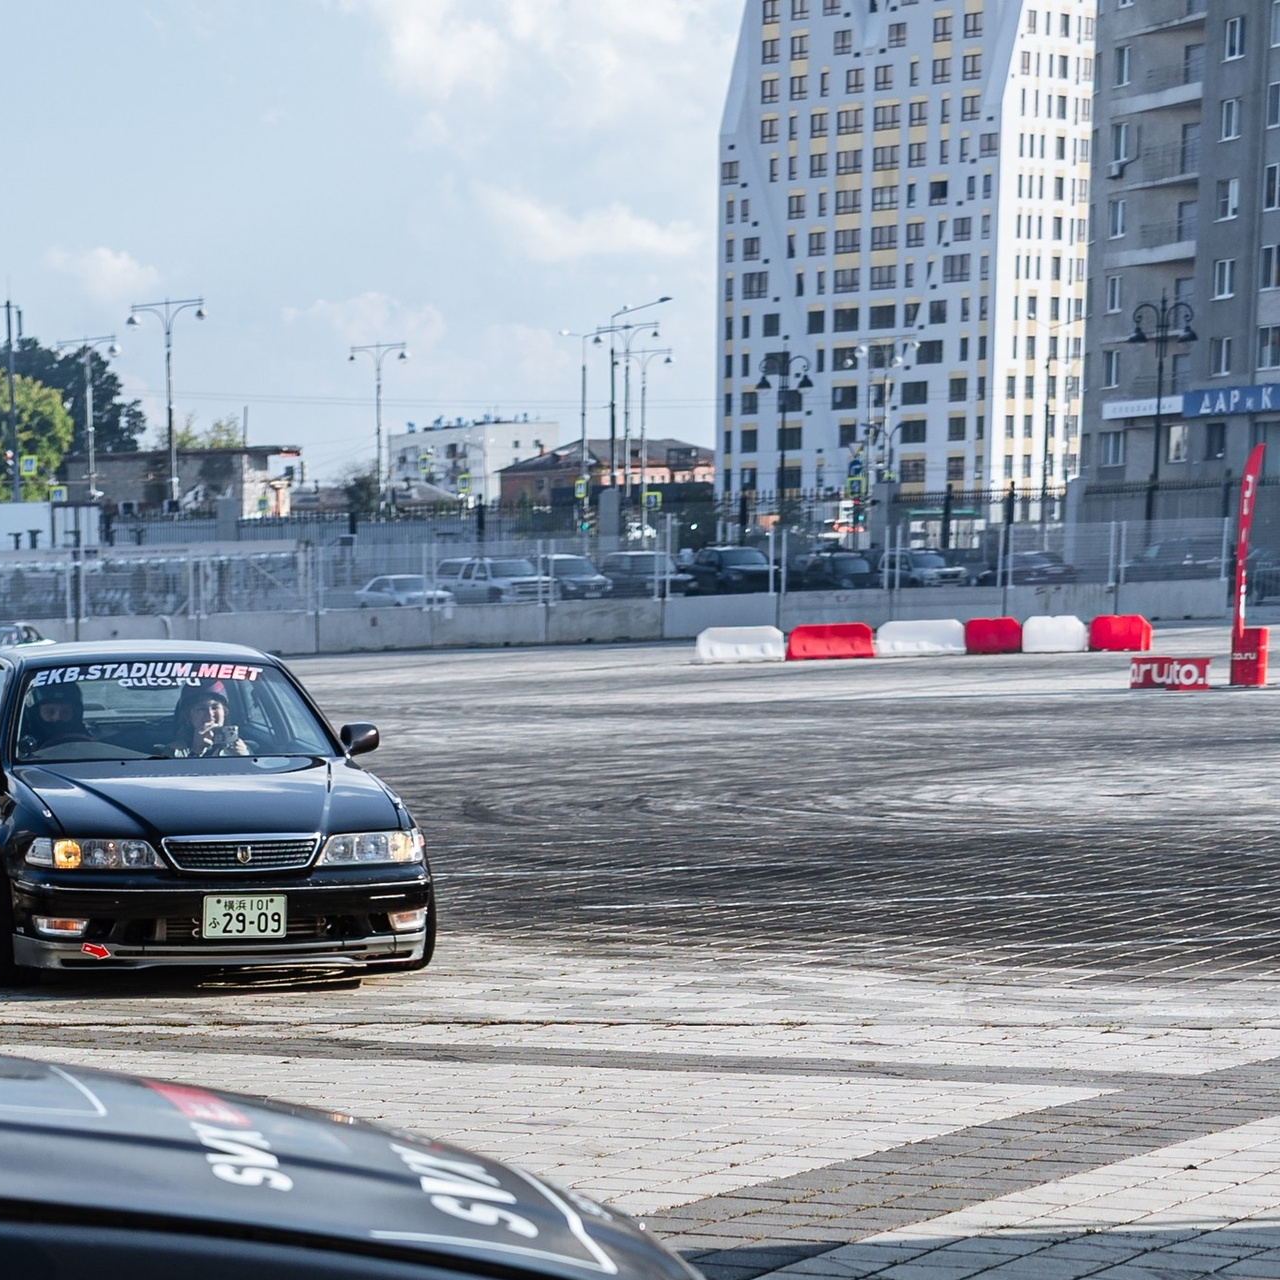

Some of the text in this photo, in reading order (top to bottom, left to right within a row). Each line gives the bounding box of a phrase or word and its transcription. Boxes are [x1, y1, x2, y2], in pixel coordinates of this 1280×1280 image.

[32, 662, 264, 688] EKB.STADIUM.MEET
[118, 674, 201, 688] auto.ru
[250, 899, 269, 911] 101
[208, 912, 282, 934] ふ 29-09
